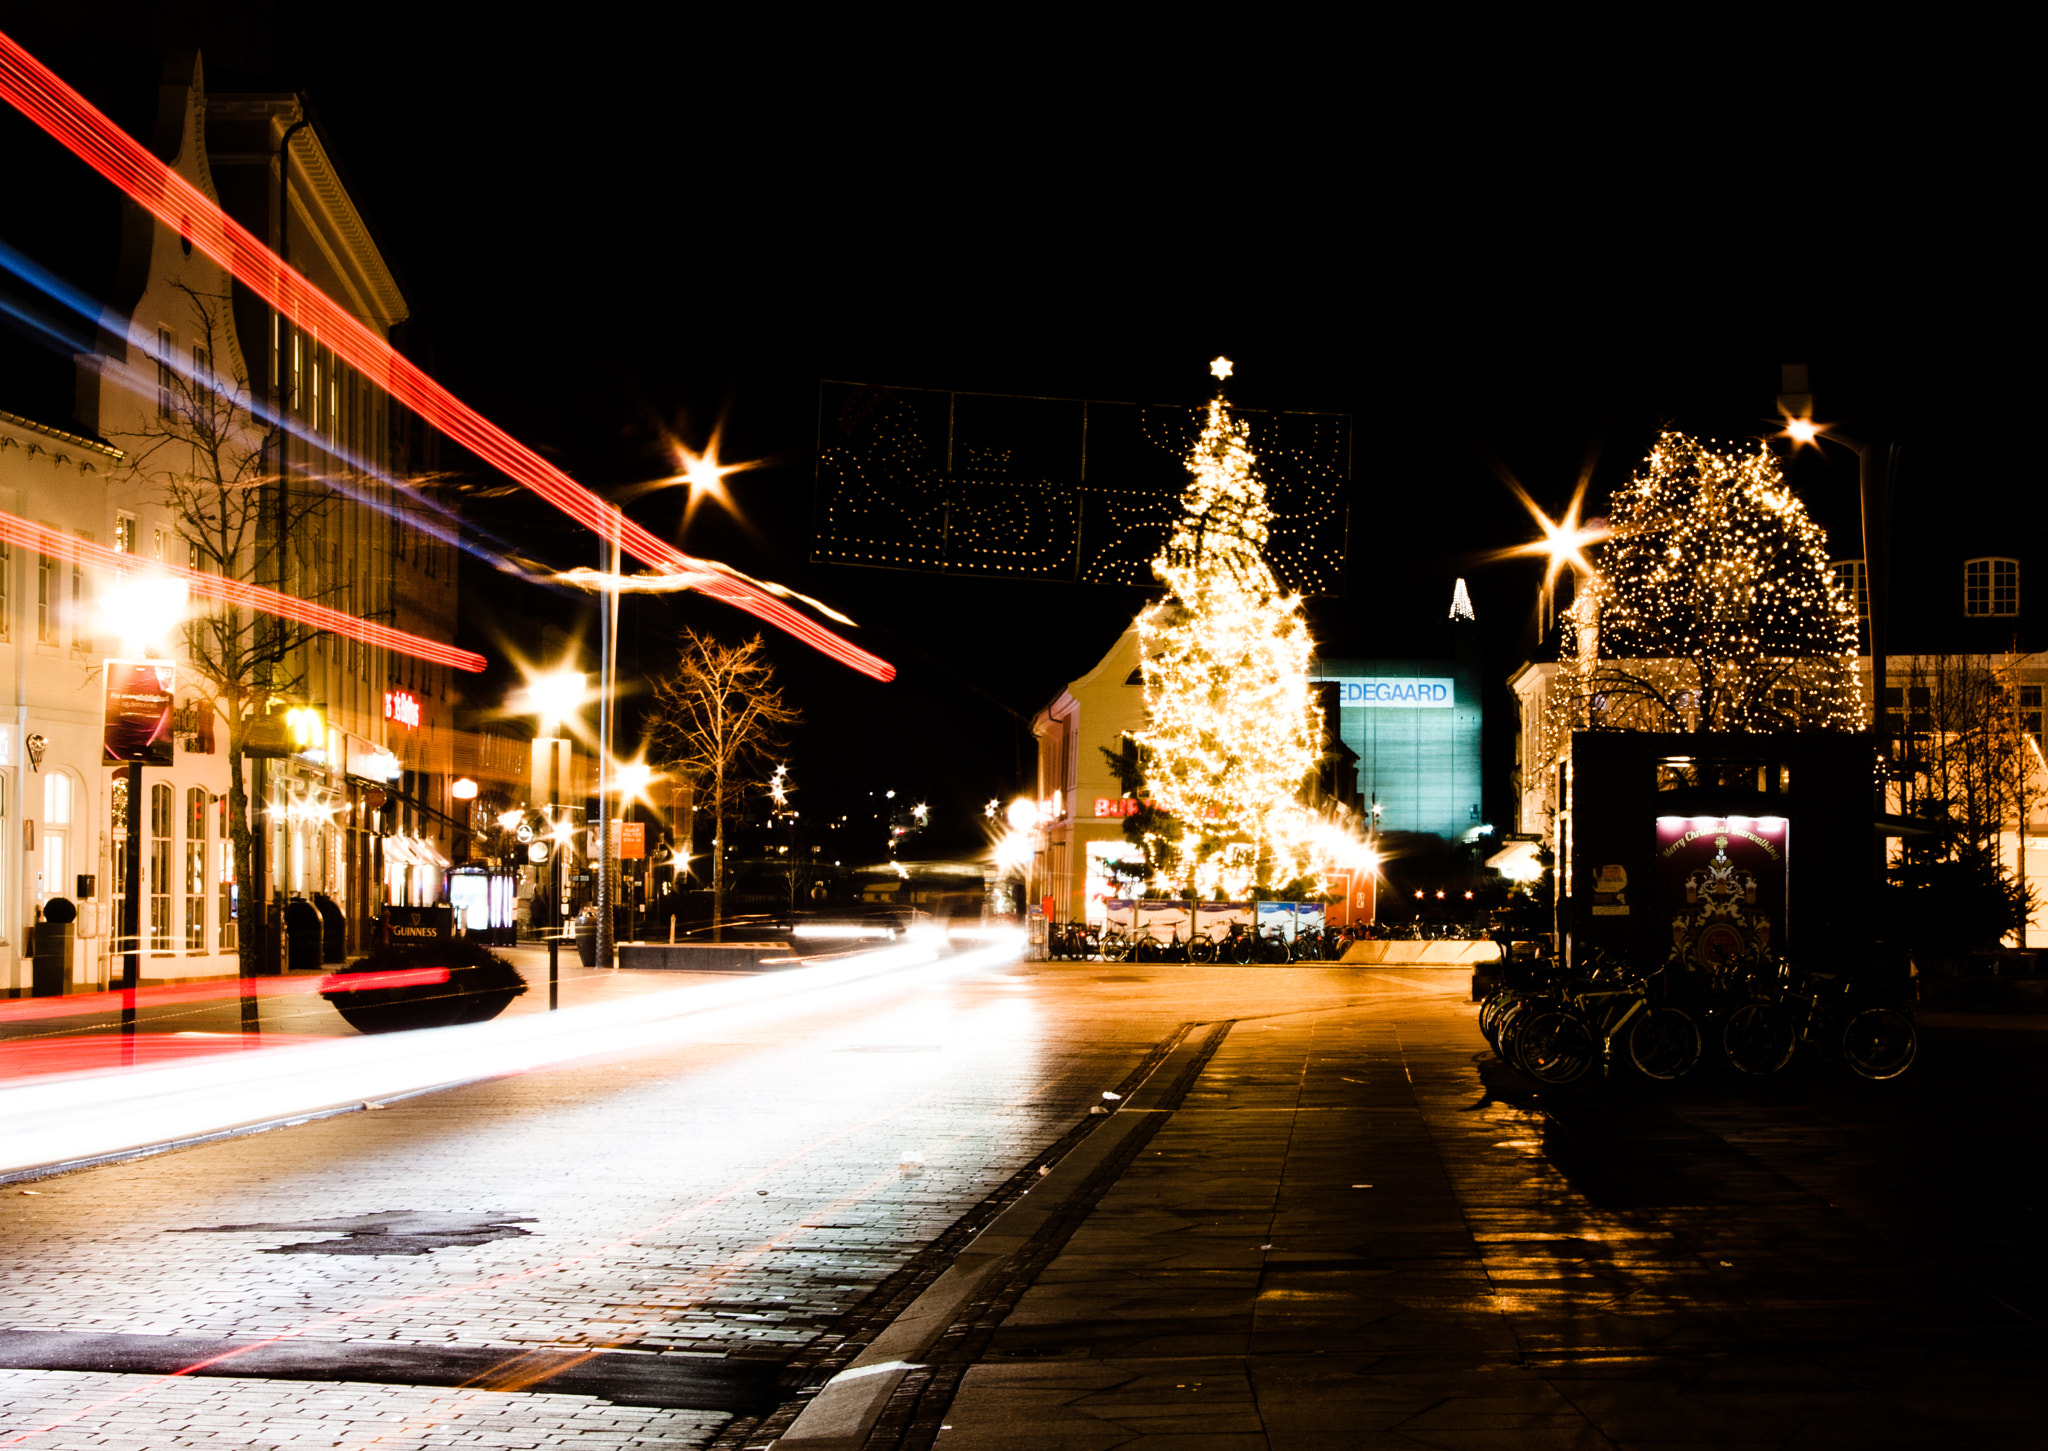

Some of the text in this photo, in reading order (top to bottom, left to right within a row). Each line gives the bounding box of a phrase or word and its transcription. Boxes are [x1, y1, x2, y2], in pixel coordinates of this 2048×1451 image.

[1339, 683, 1447, 702] EDEGAARD
[1684, 825, 1730, 842] Christmas
[1731, 826, 1782, 860] Beerwalking
[393, 925, 437, 937] GUINNESS
